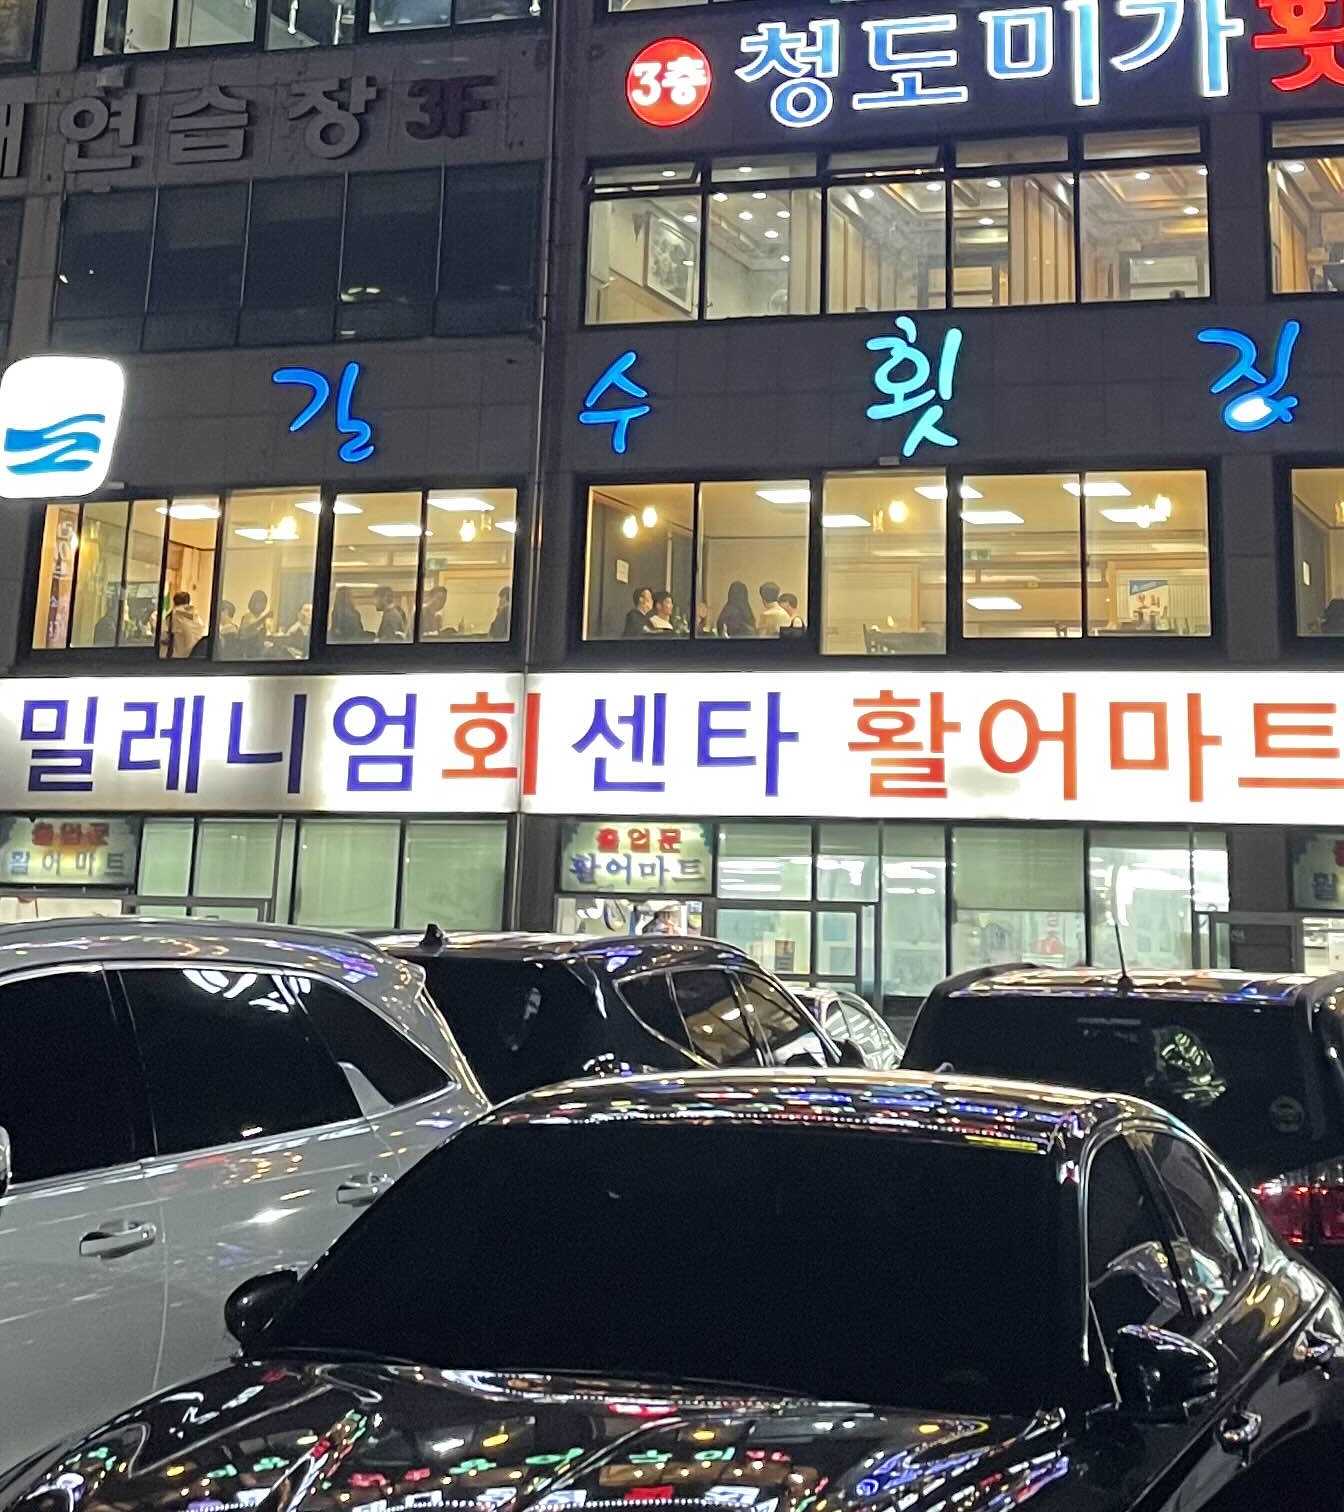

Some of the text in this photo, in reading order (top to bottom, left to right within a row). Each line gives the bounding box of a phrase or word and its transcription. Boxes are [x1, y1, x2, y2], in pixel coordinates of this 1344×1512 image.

[404, 75, 491, 141] 3F
[628, 59, 709, 106] 3층
[19, 691, 799, 797] 밀레니엄회센타
[569, 854, 706, 886] 활어마트
